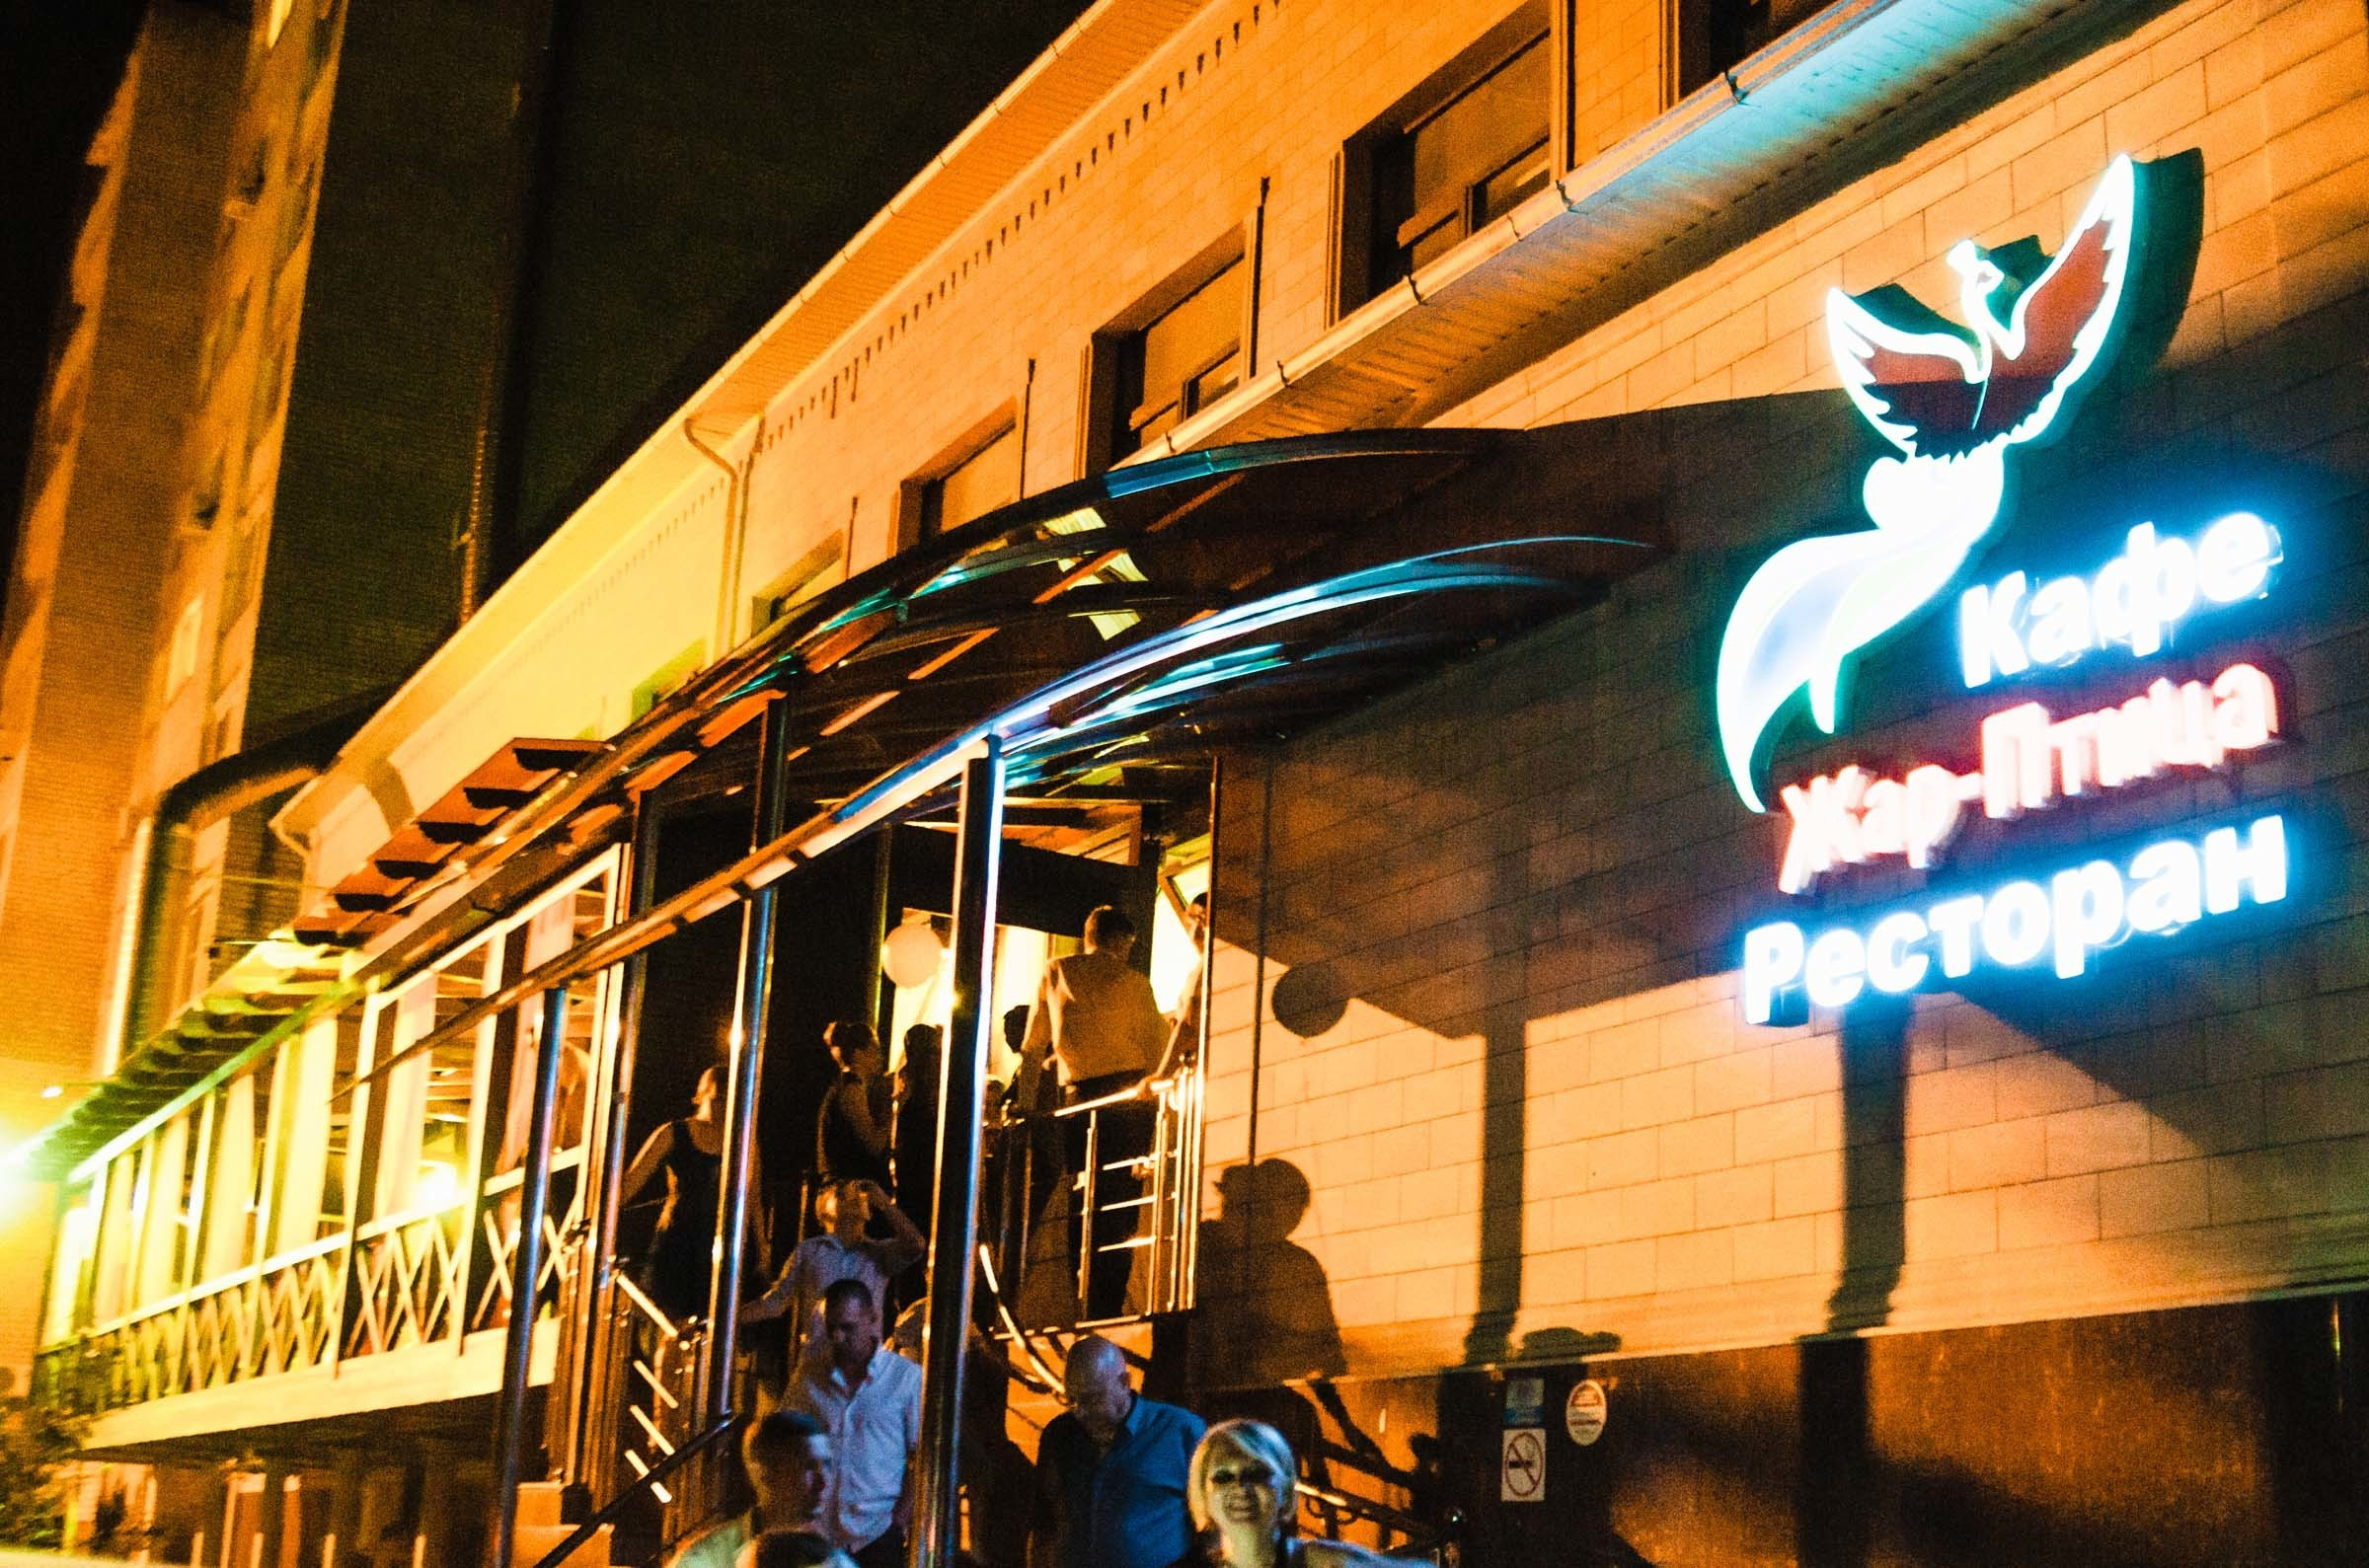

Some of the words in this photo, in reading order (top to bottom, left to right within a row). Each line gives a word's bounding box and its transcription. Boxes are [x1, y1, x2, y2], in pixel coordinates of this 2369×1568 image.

[1960, 511, 2282, 688] Кафе
[1779, 662, 2278, 895] Жар-Птица
[1744, 814, 2287, 1025] Ресторан
